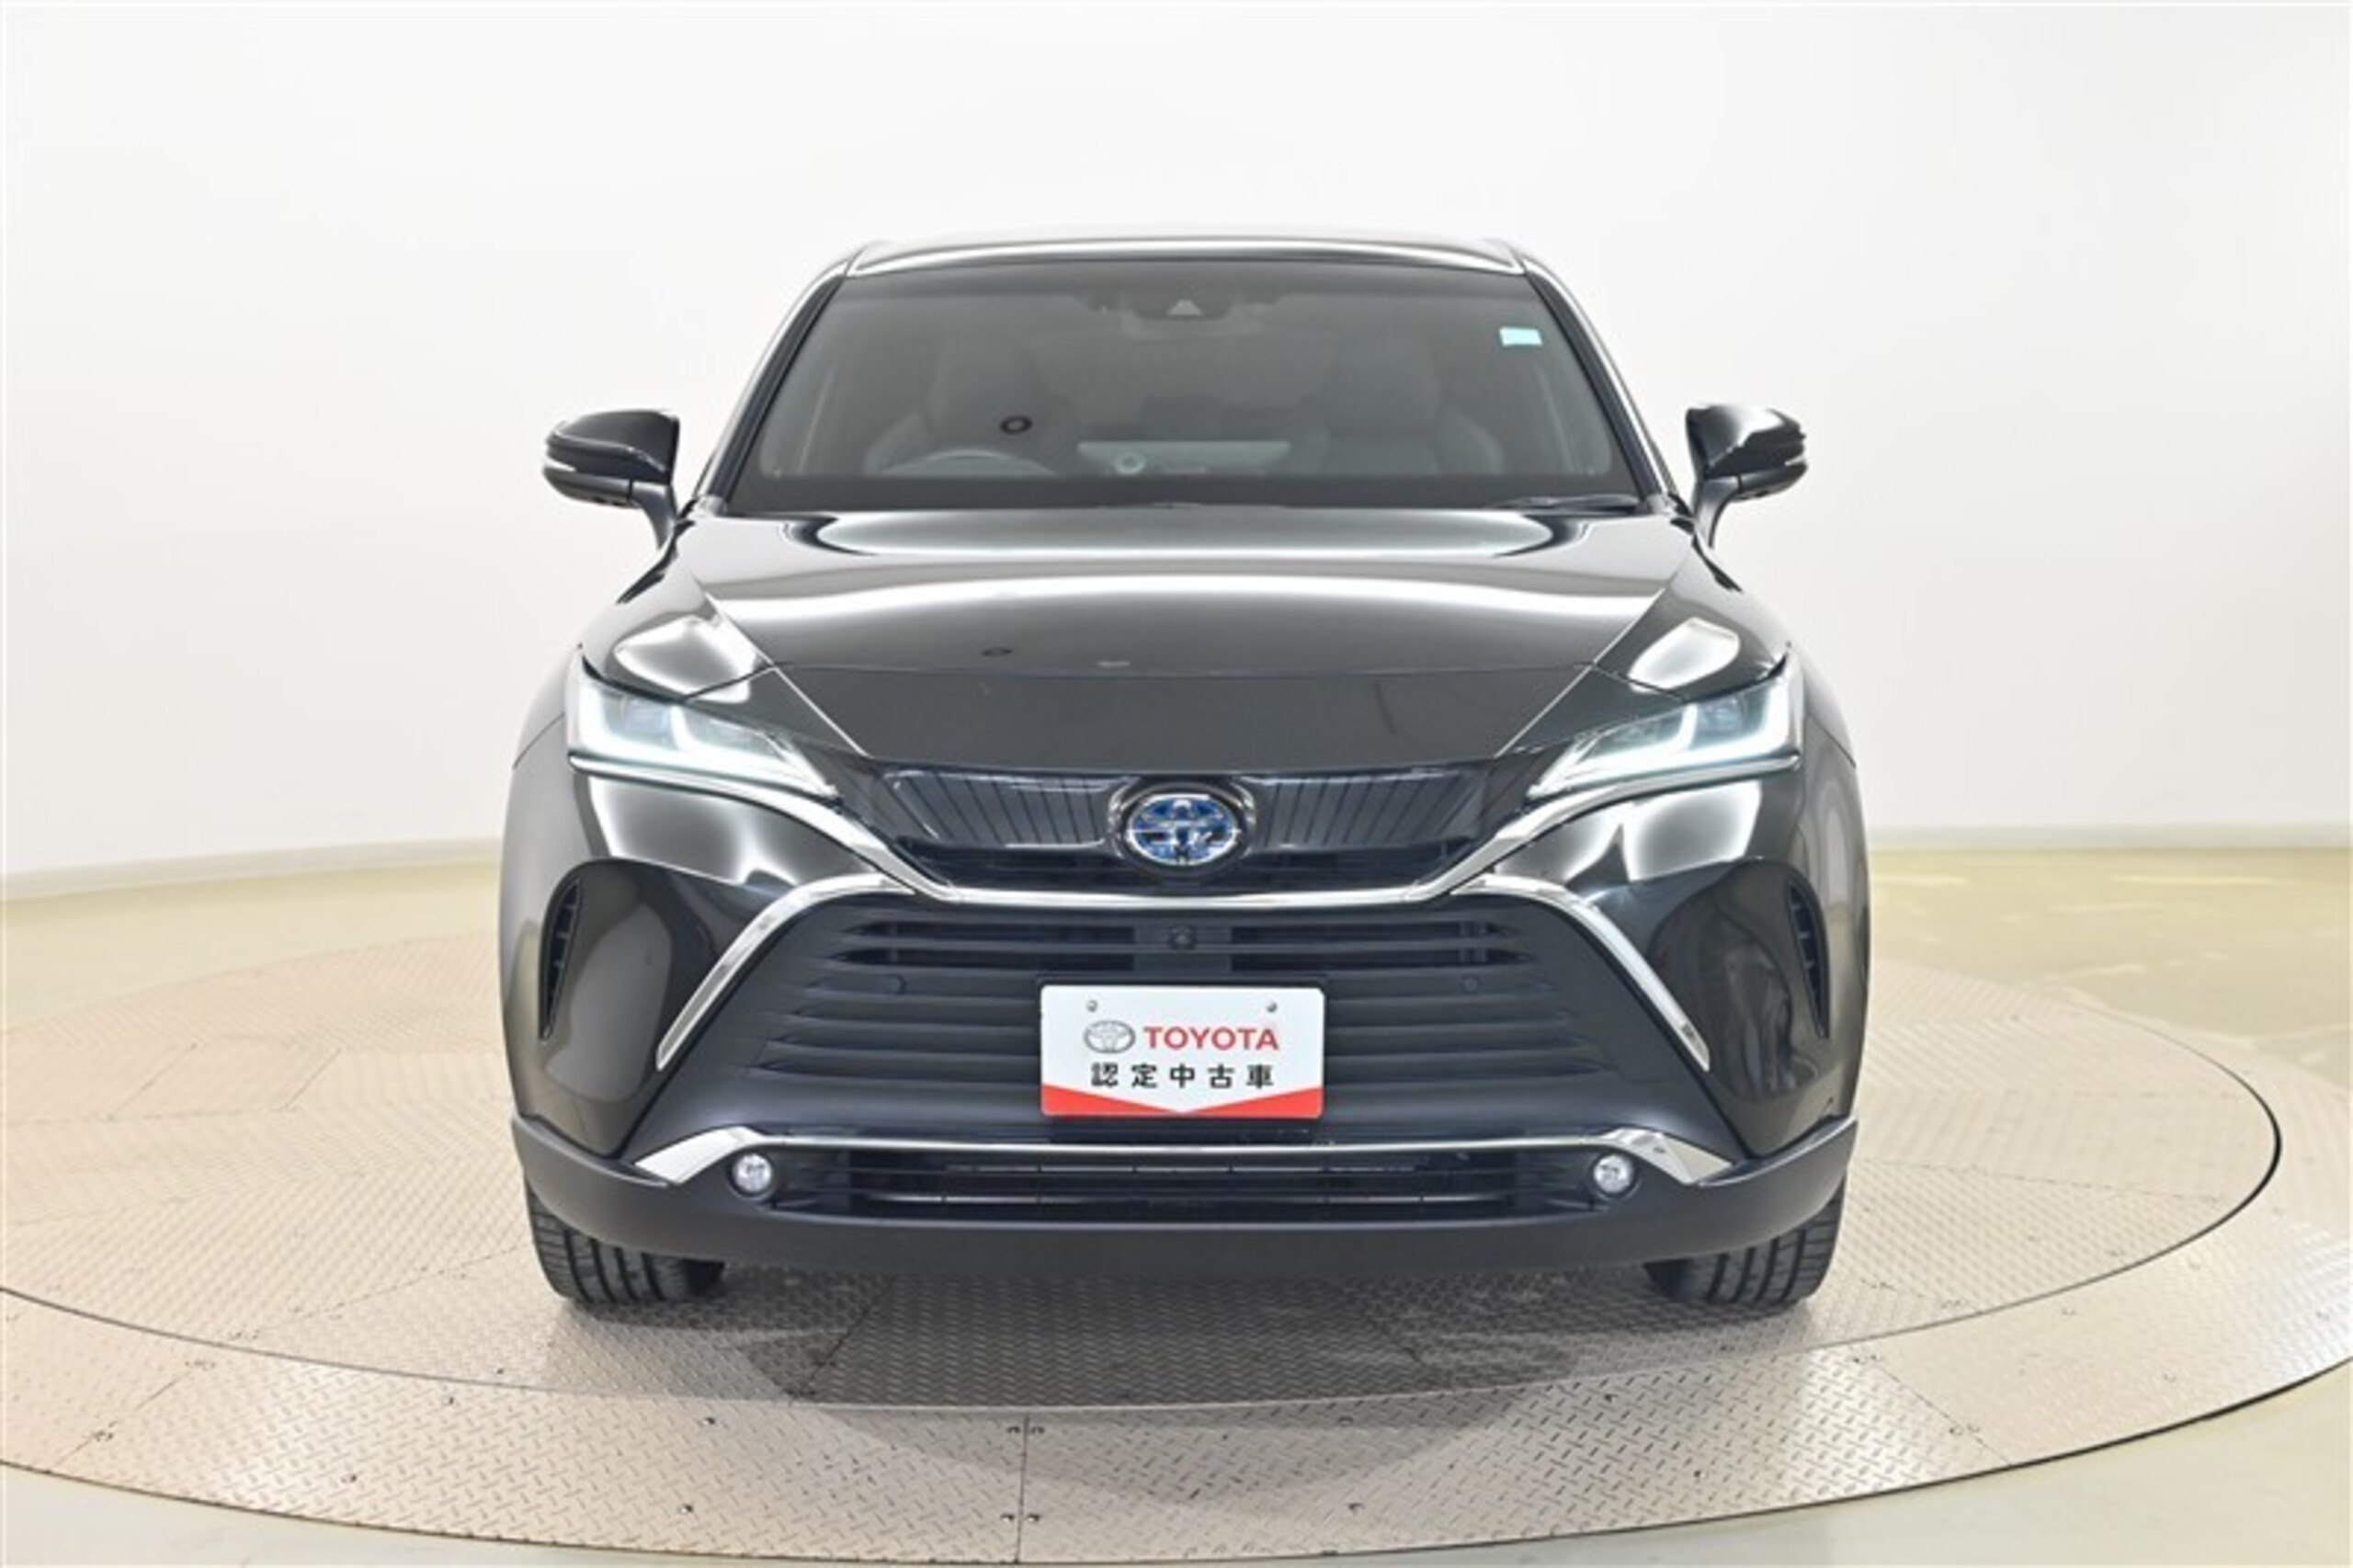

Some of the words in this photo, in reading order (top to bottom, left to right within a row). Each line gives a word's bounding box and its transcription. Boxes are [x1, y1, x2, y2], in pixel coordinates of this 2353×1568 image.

[1142, 1026, 1279, 1051] TOYOTA
[1090, 1062, 1274, 1089] 認定中古車
